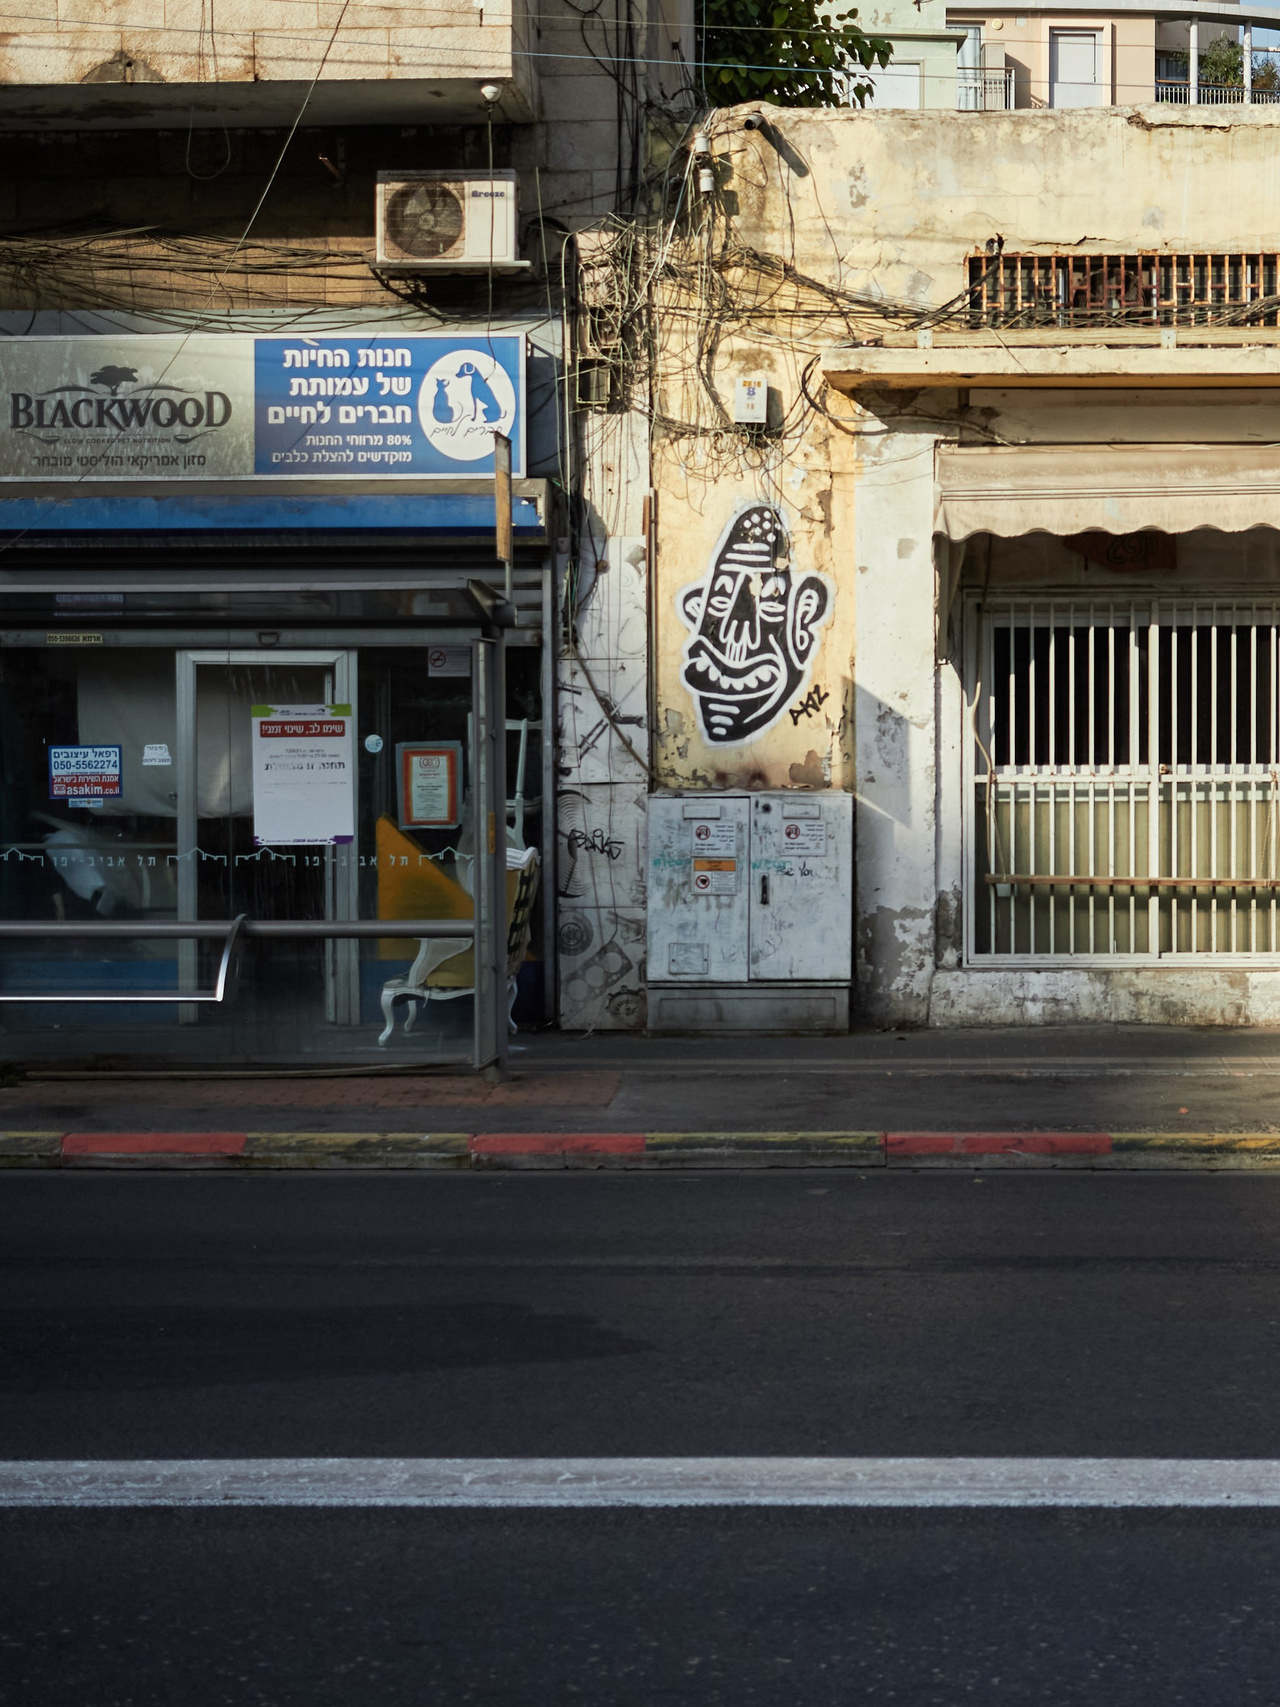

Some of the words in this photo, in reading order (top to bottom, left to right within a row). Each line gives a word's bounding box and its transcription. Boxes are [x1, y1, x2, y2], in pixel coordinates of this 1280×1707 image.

[283, 348, 350, 368] החיות
[357, 348, 412, 368] חנות
[289, 377, 370, 396] עמותת
[376, 372, 412, 396] של
[10, 391, 233, 431] BLACKWOOD
[267, 400, 332, 424] לחיים
[339, 405, 412, 424] חברים
[306, 435, 343, 446] החנות
[346, 435, 384, 446] מרווחי
[387, 435, 412, 446] 80%
[127, 454, 180, 470] אמריקאי
[183, 454, 207, 469] מזון
[272, 449, 309, 463] כלבים
[312, 449, 354, 463] להצלת
[357, 451, 412, 465] מוקדשים
[322, 724, 343, 734] שימו
[53, 750, 89, 759] עיצובים
[91, 748, 118, 758] רפאל
[53, 759, 118, 770] 050-5562274
[66, 783, 120, 796] asakim.co.il
[53, 856, 125, 867] אביב-יפו
[137, 854, 156, 867] תל
[389, 854, 408, 866] תל
